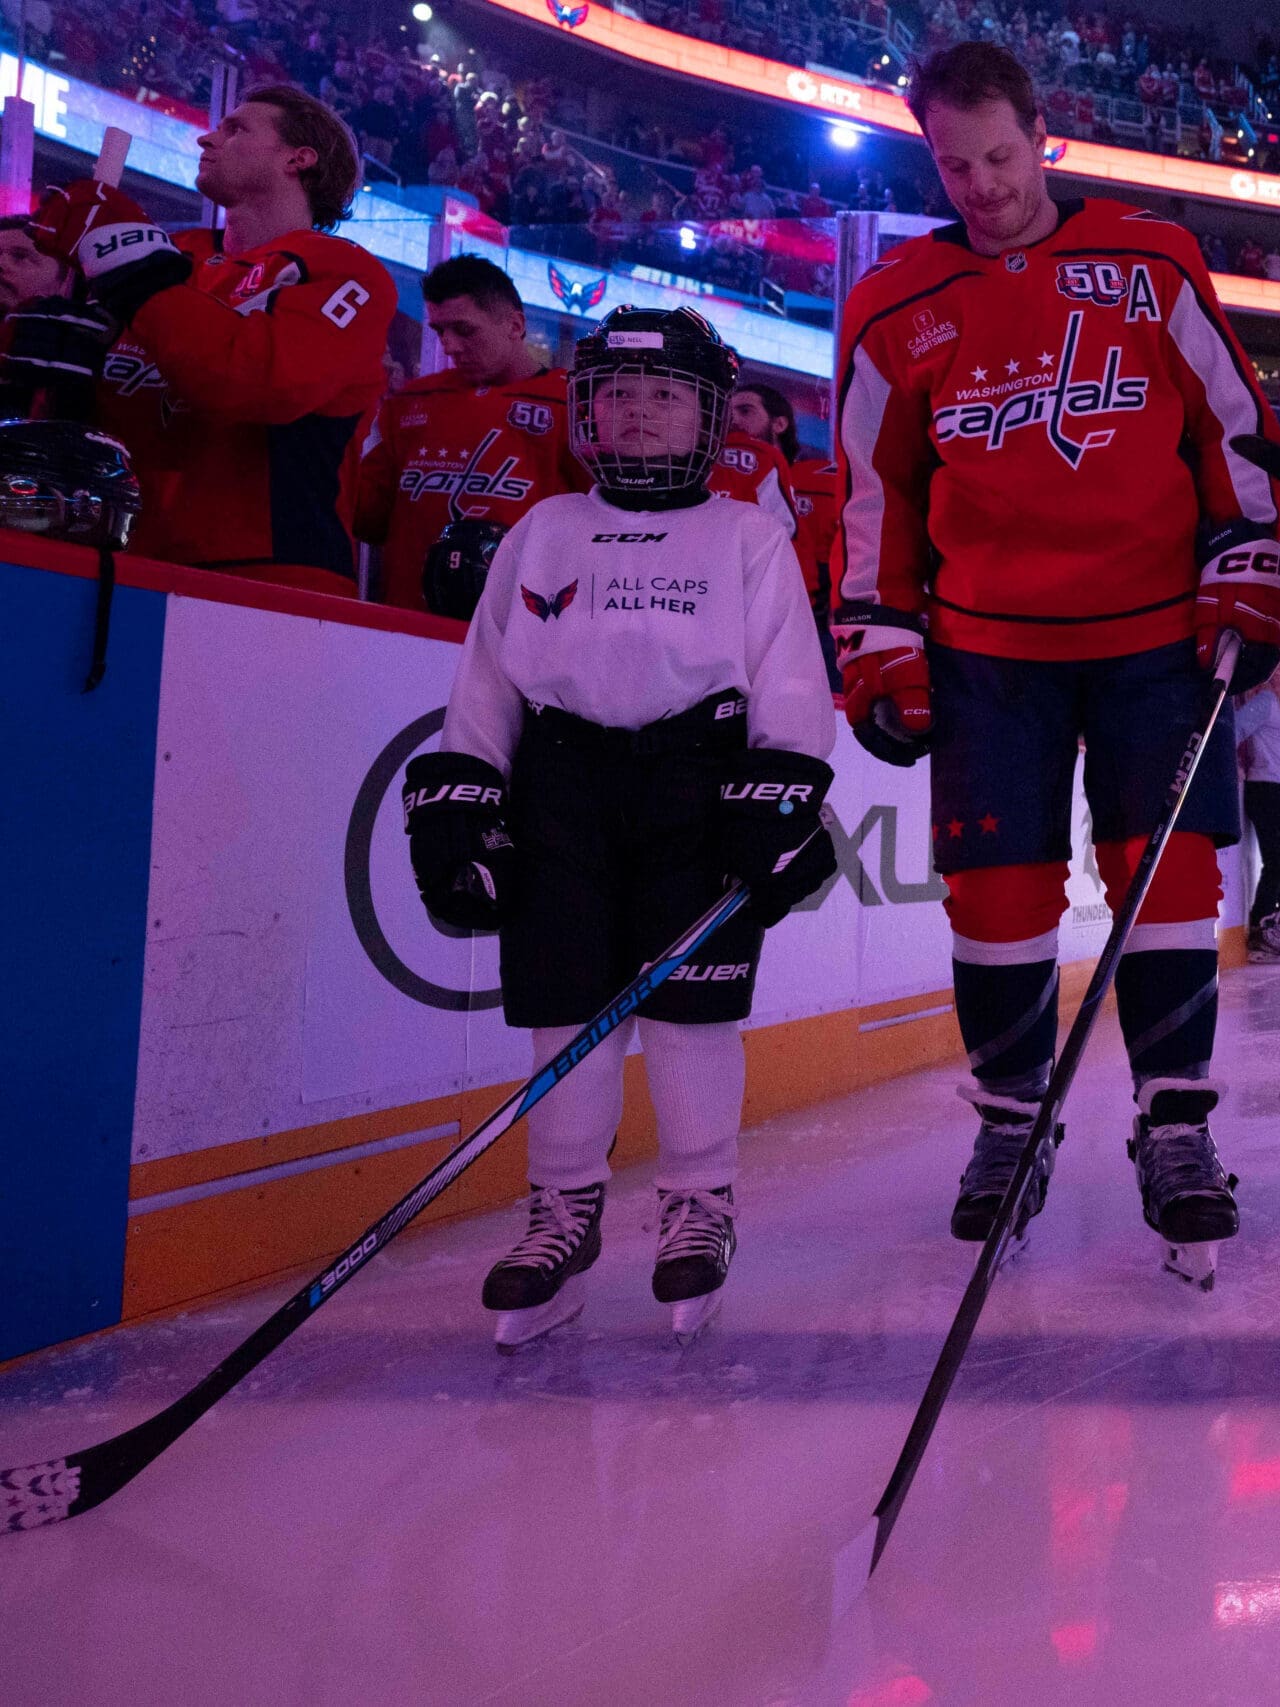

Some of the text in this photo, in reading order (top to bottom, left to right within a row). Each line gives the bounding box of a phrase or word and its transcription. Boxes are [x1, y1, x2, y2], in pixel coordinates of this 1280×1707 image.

[820, 83, 861, 111] RTX
[1063, 263, 1124, 297] 50
[1124, 264, 1162, 323] A
[320, 279, 370, 330] 6
[907, 321, 956, 350] CAESARS
[911, 330, 959, 359] SPORTSBOOK
[956, 372, 1054, 401] WASHINGTON
[723, 448, 757, 471] 50
[592, 532, 668, 543] CCM
[449, 551, 461, 569] 9
[606, 577, 709, 595] ALL CAPS
[604, 596, 696, 615] ALL HER
[1167, 731, 1204, 793] CCM
